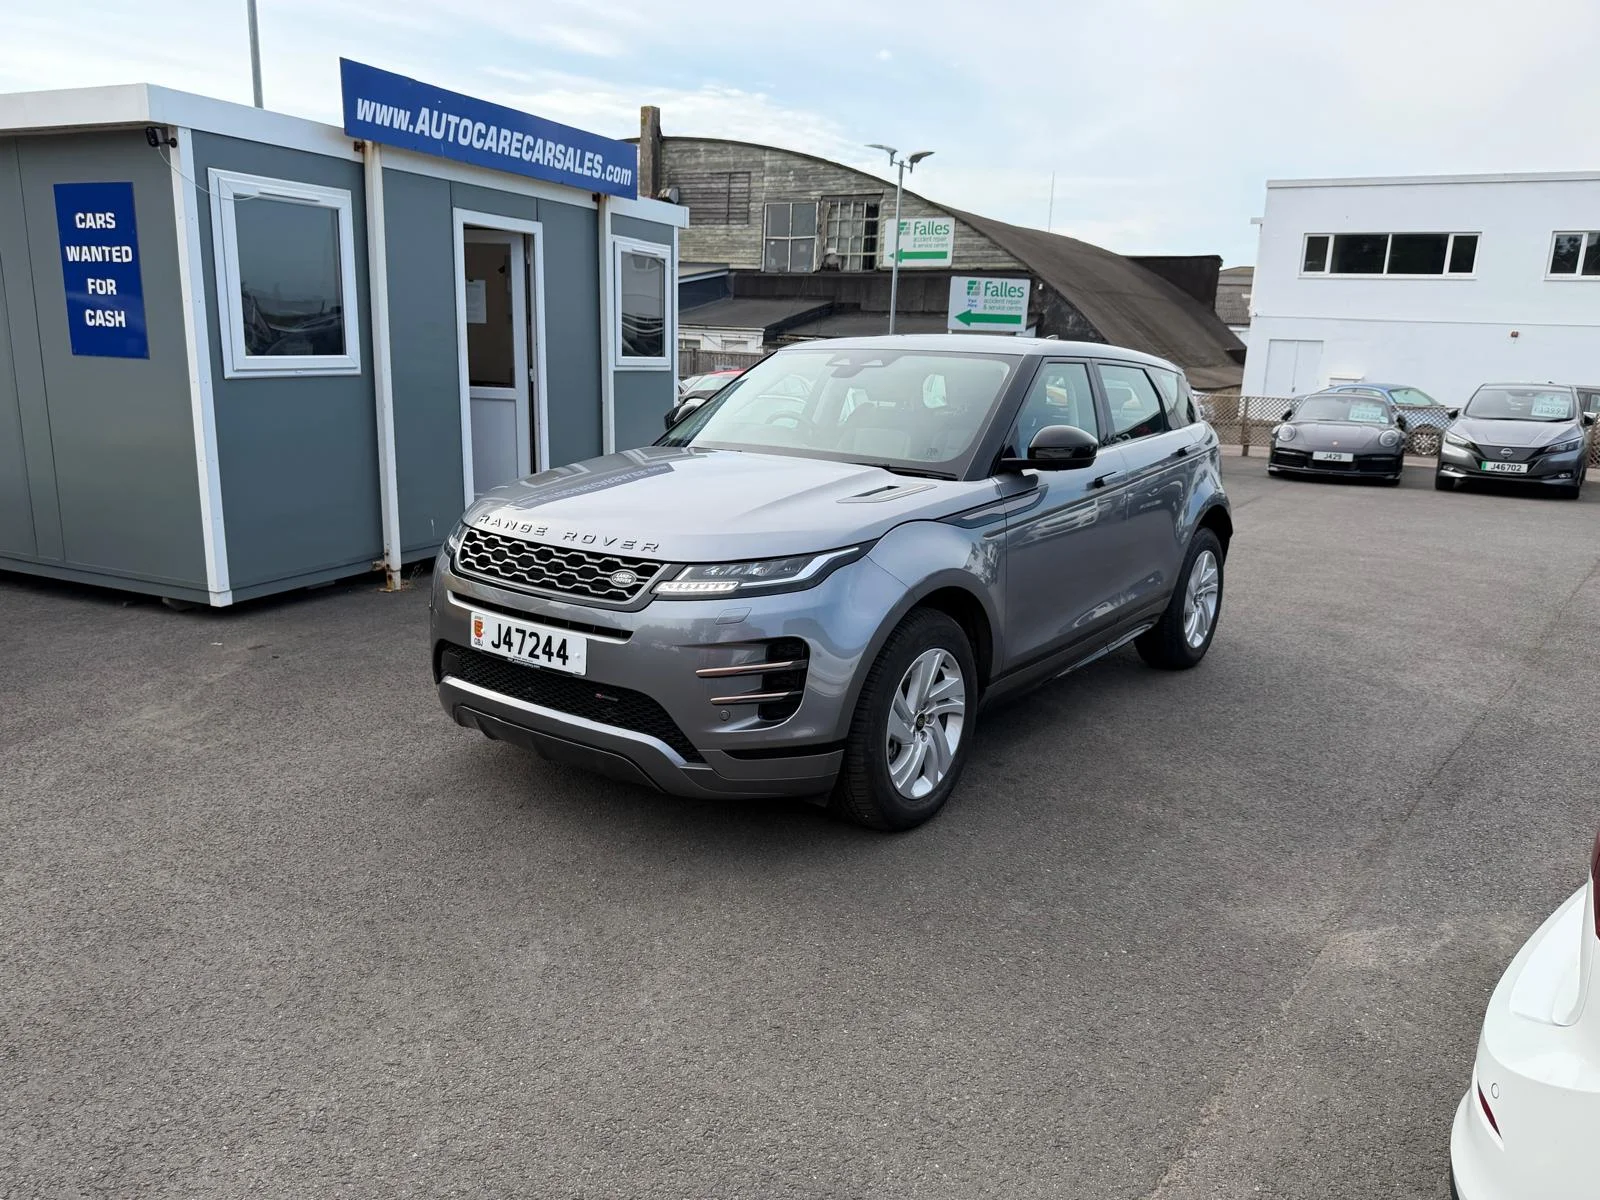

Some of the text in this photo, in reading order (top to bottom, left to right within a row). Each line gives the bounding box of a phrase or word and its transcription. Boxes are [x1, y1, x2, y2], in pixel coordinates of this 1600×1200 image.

[356, 98, 632, 186] www.AUTOCARECARSALES.com
[75, 212, 116, 229] CARS
[914, 221, 950, 235] Falles
[66, 245, 133, 263] WANTED
[87, 278, 117, 295] FOR
[984, 281, 1025, 298] Falles
[85, 309, 126, 328] CASH
[1491, 463, 1522, 472] J46702
[479, 514, 660, 553] RANGE ROVER
[491, 623, 569, 666] J47244
